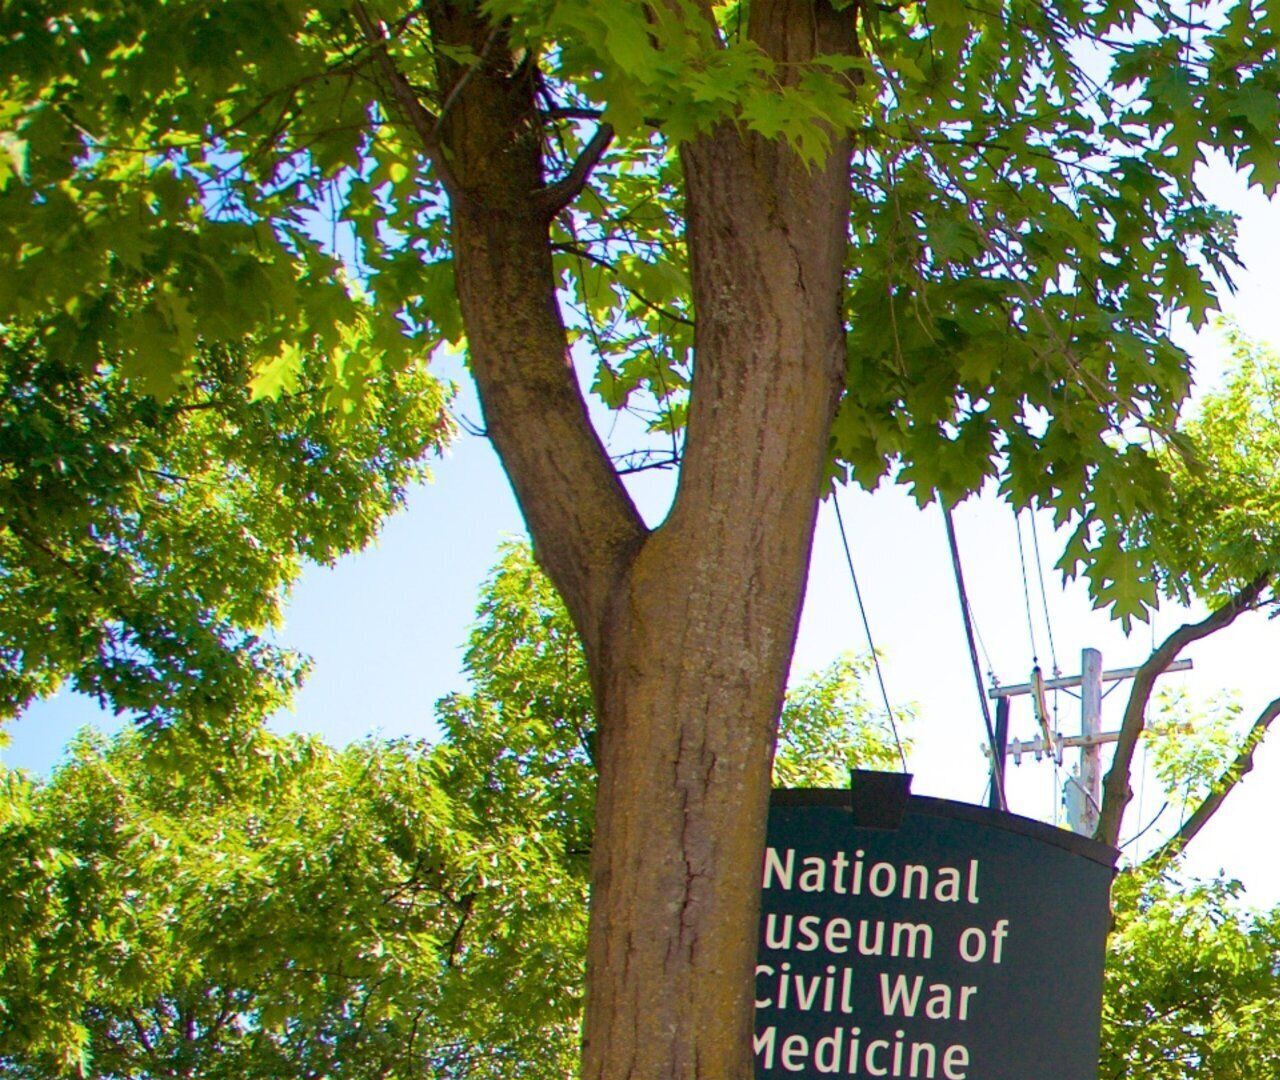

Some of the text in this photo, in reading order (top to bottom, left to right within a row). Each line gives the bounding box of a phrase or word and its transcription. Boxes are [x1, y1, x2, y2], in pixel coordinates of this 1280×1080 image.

[762, 847, 980, 904] National
[764, 911, 1009, 964] useum of
[753, 963, 978, 1021] Civil War
